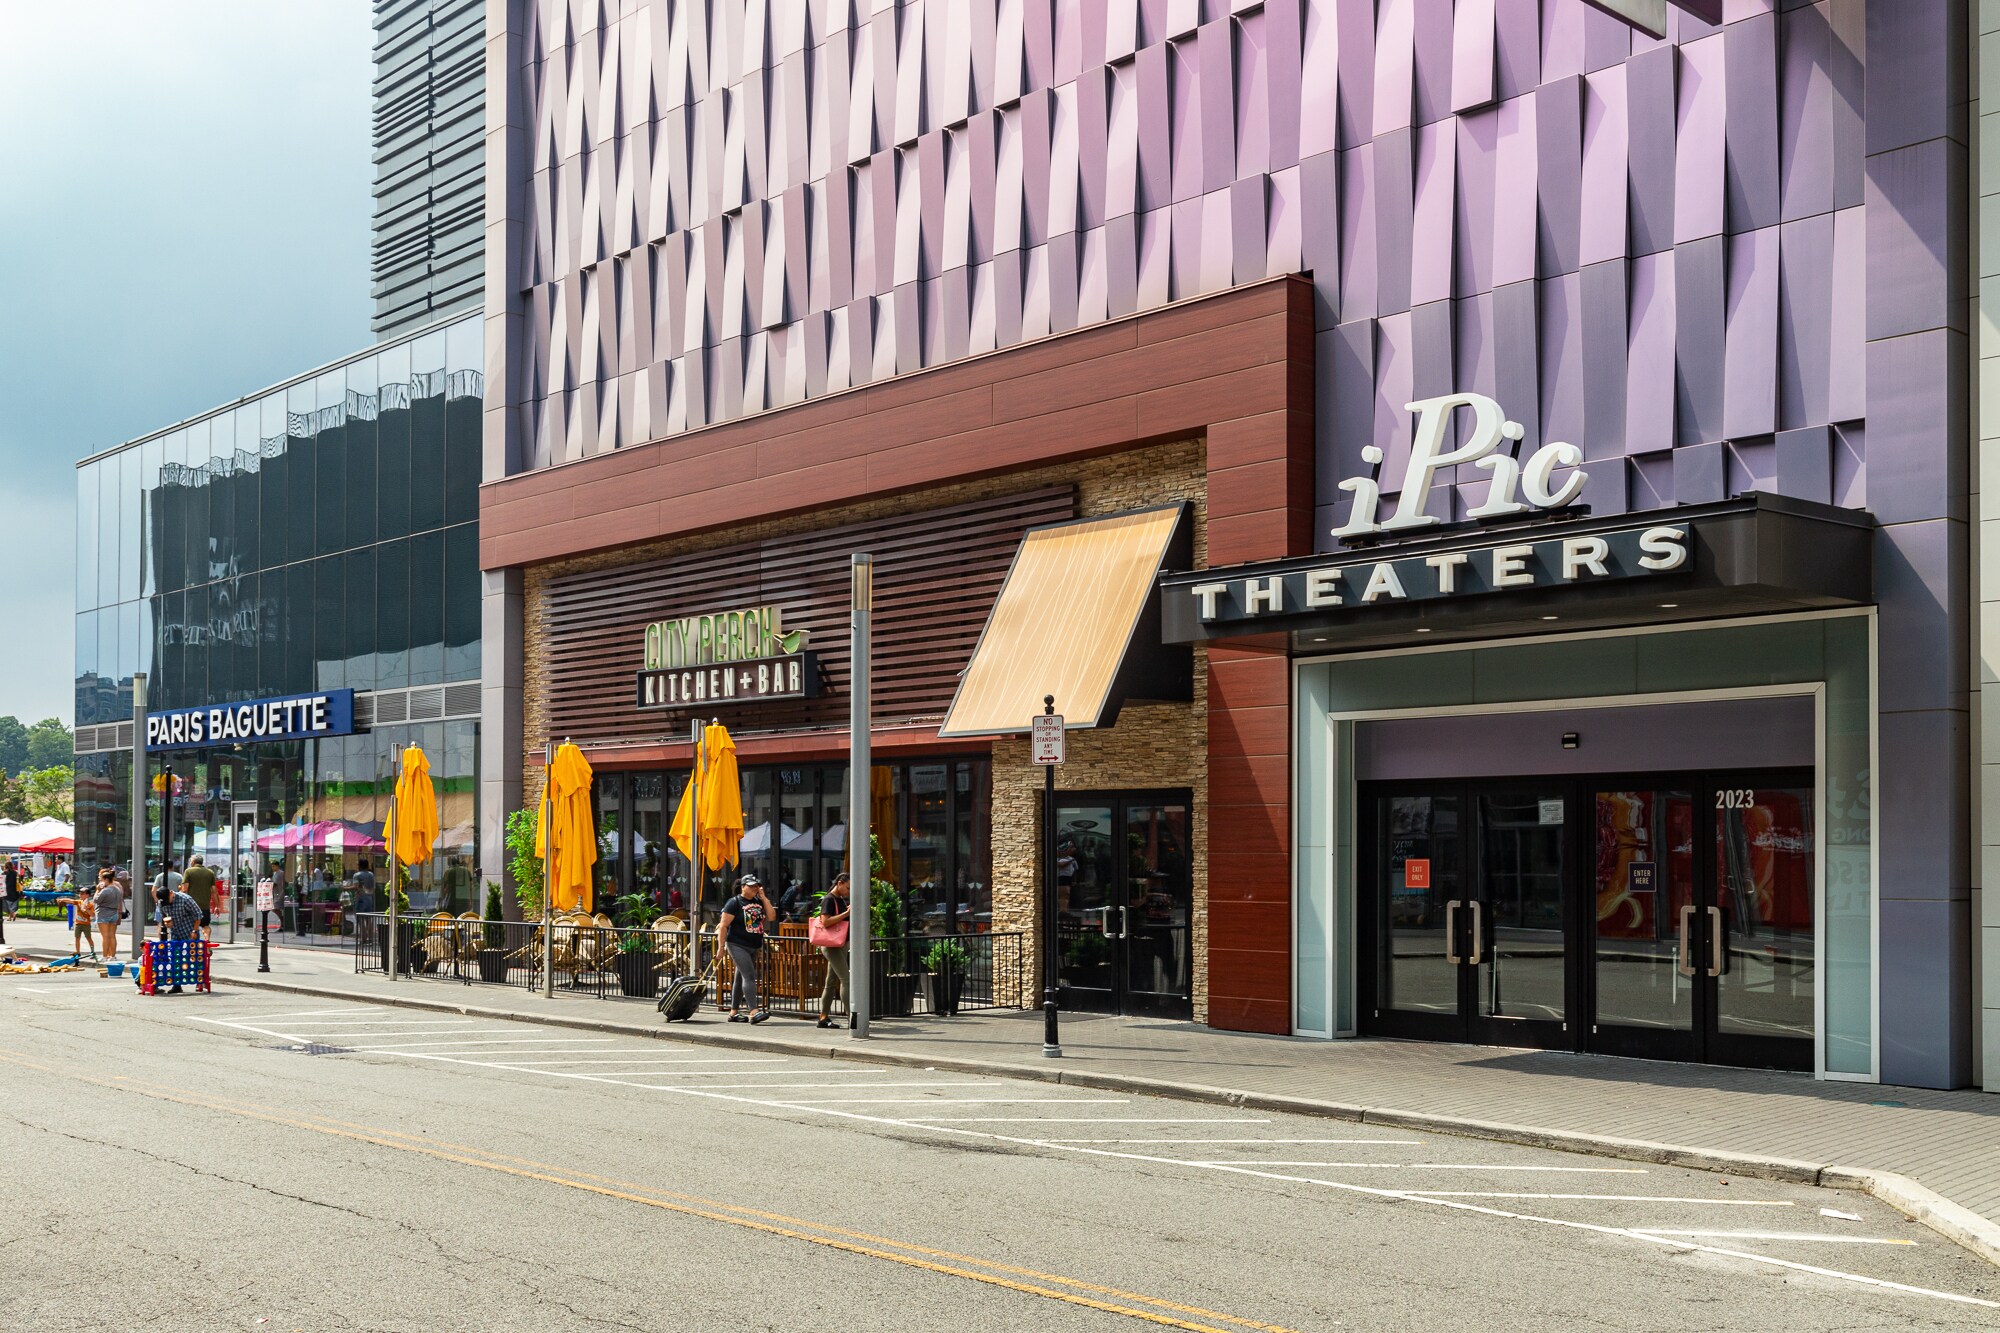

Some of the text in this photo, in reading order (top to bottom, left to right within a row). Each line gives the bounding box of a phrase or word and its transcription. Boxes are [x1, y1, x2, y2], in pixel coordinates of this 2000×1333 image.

[1331, 393, 1589, 536] iPic
[1192, 527, 1687, 619] THEATERS
[645, 606, 775, 671] CITY PERCH
[147, 696, 327, 746] PARIS BAGUETTE
[1716, 789, 1754, 809] 2023
